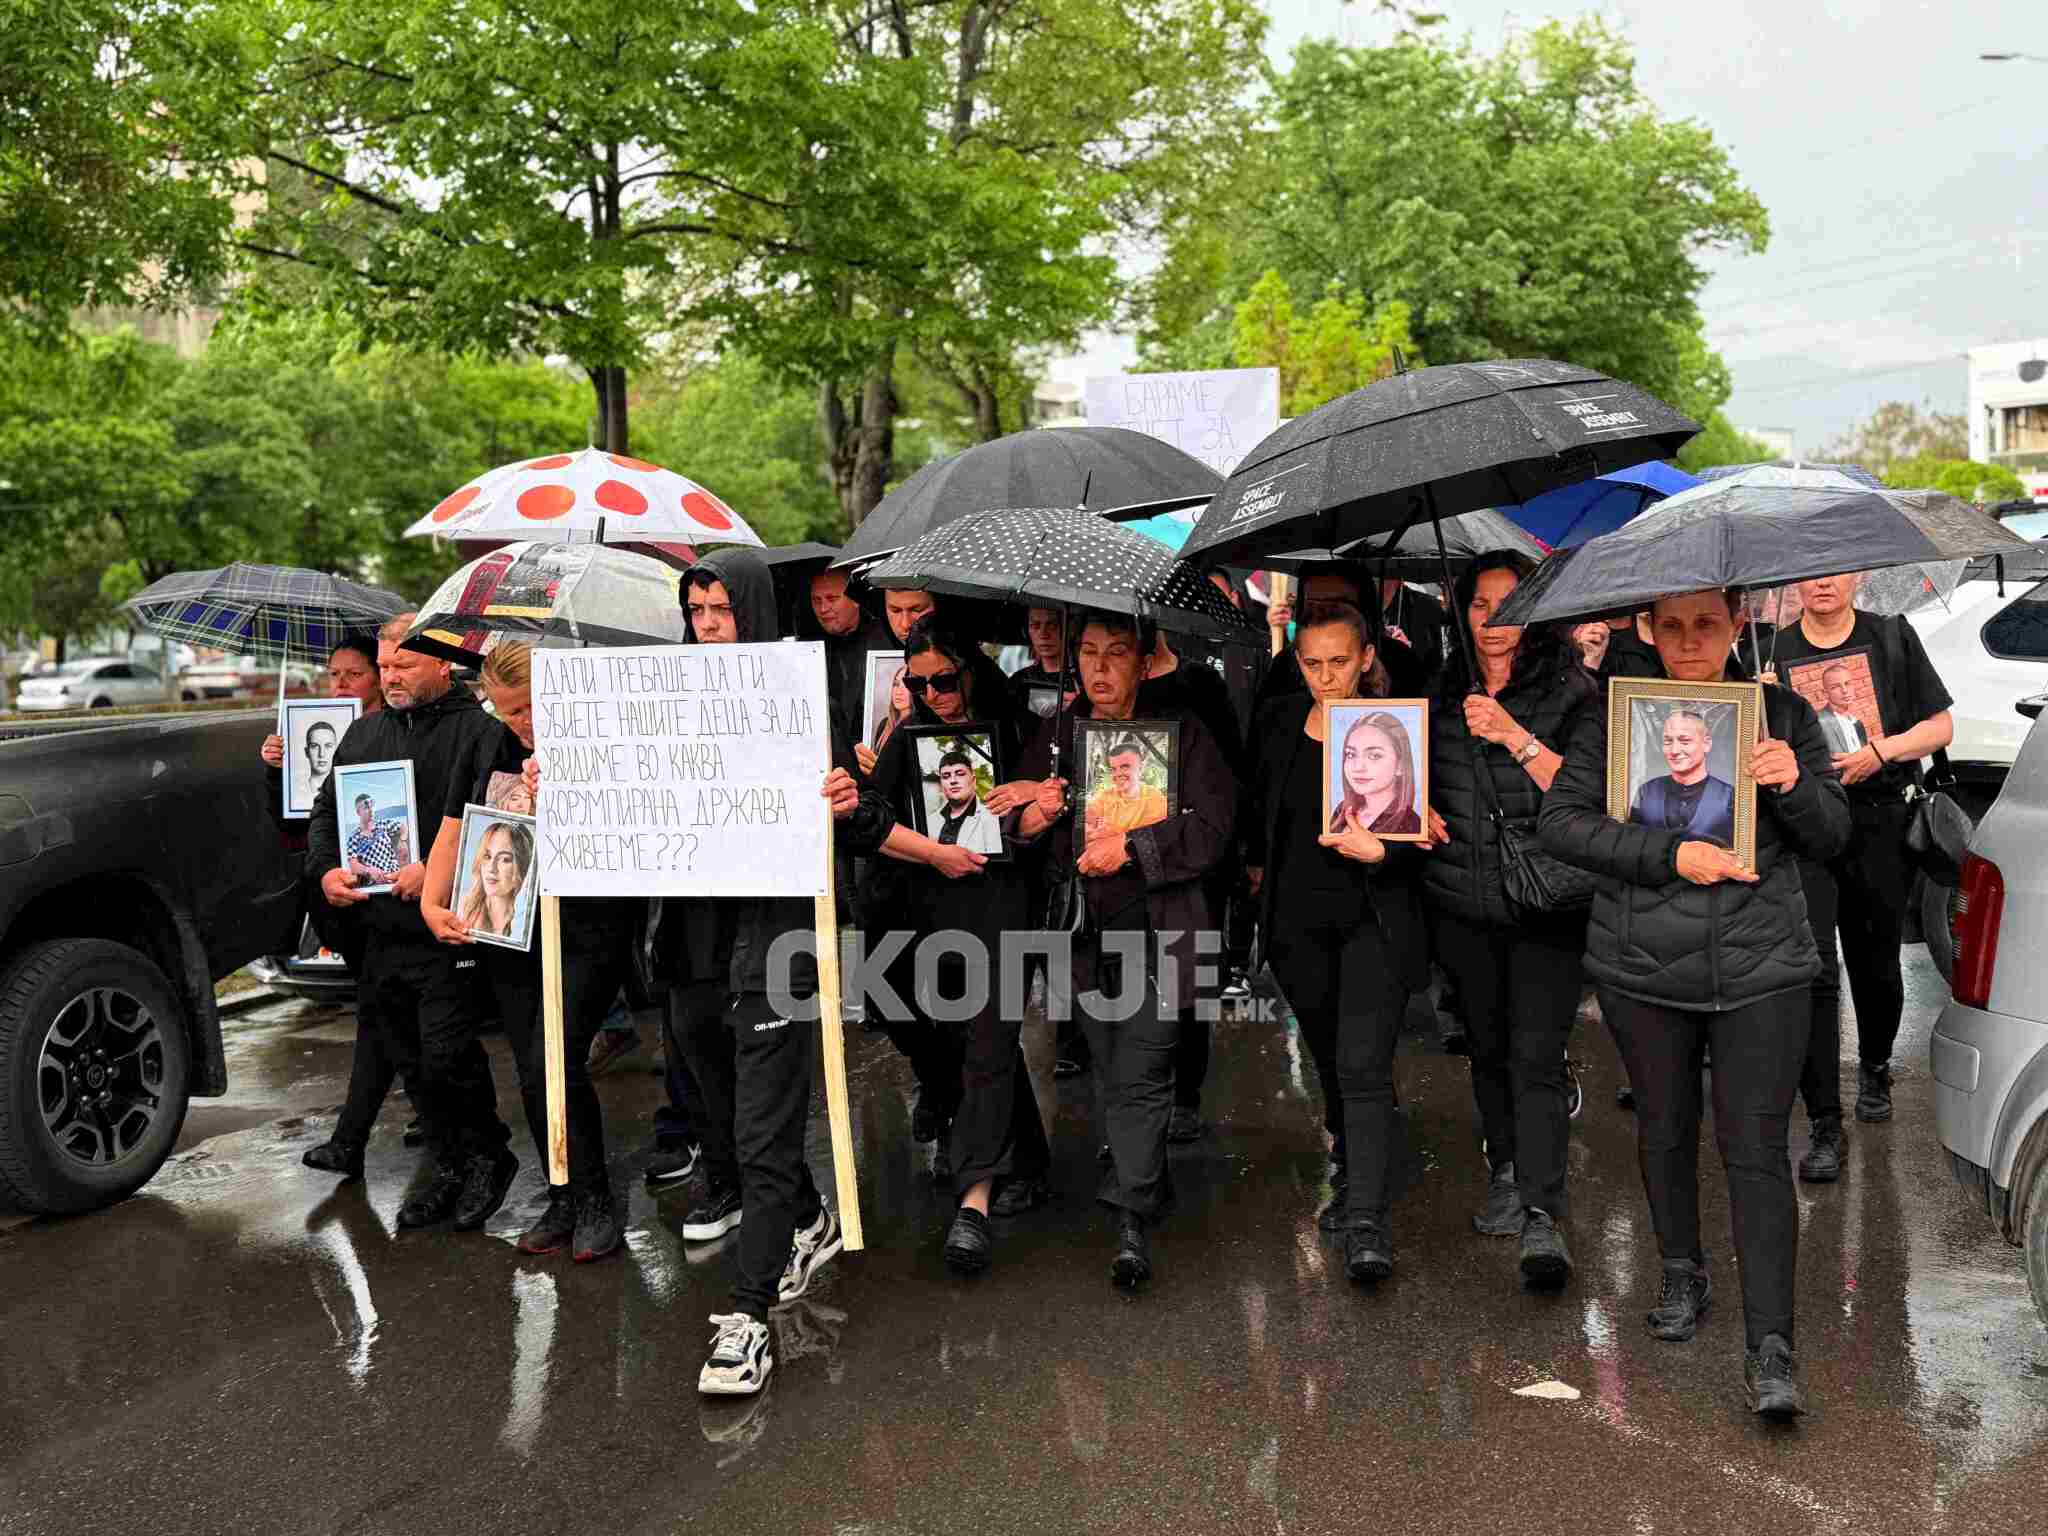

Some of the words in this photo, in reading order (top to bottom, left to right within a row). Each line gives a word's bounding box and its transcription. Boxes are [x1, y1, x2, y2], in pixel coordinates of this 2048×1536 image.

[1562, 402, 1604, 416] SPACE
[1579, 411, 1641, 428] ASSEMBLY
[1230, 490, 1287, 522] ASSEMBLY
[1240, 481, 1275, 504] SPACE
[541, 656, 597, 699] ДАЛИ
[602, 655, 693, 693] ТРЕБАШЕ
[700, 655, 729, 695] ДА
[738, 654, 768, 690] ГИ
[541, 701, 609, 738] УБИЕТЕ
[617, 699, 688, 736] НАШИТЕ
[696, 698, 752, 738] ДЕЦА
[759, 698, 782, 735] ЗА
[785, 698, 813, 738] ДА
[541, 744, 627, 785] УВИДИМЕ
[636, 744, 659, 781] ВО
[668, 743, 726, 781] КАКВА
[544, 788, 680, 828] КОРУМПИРАНА
[690, 788, 790, 829] ДРЖАВА
[545, 833, 699, 871] ЖИВЕЕМЕ???
